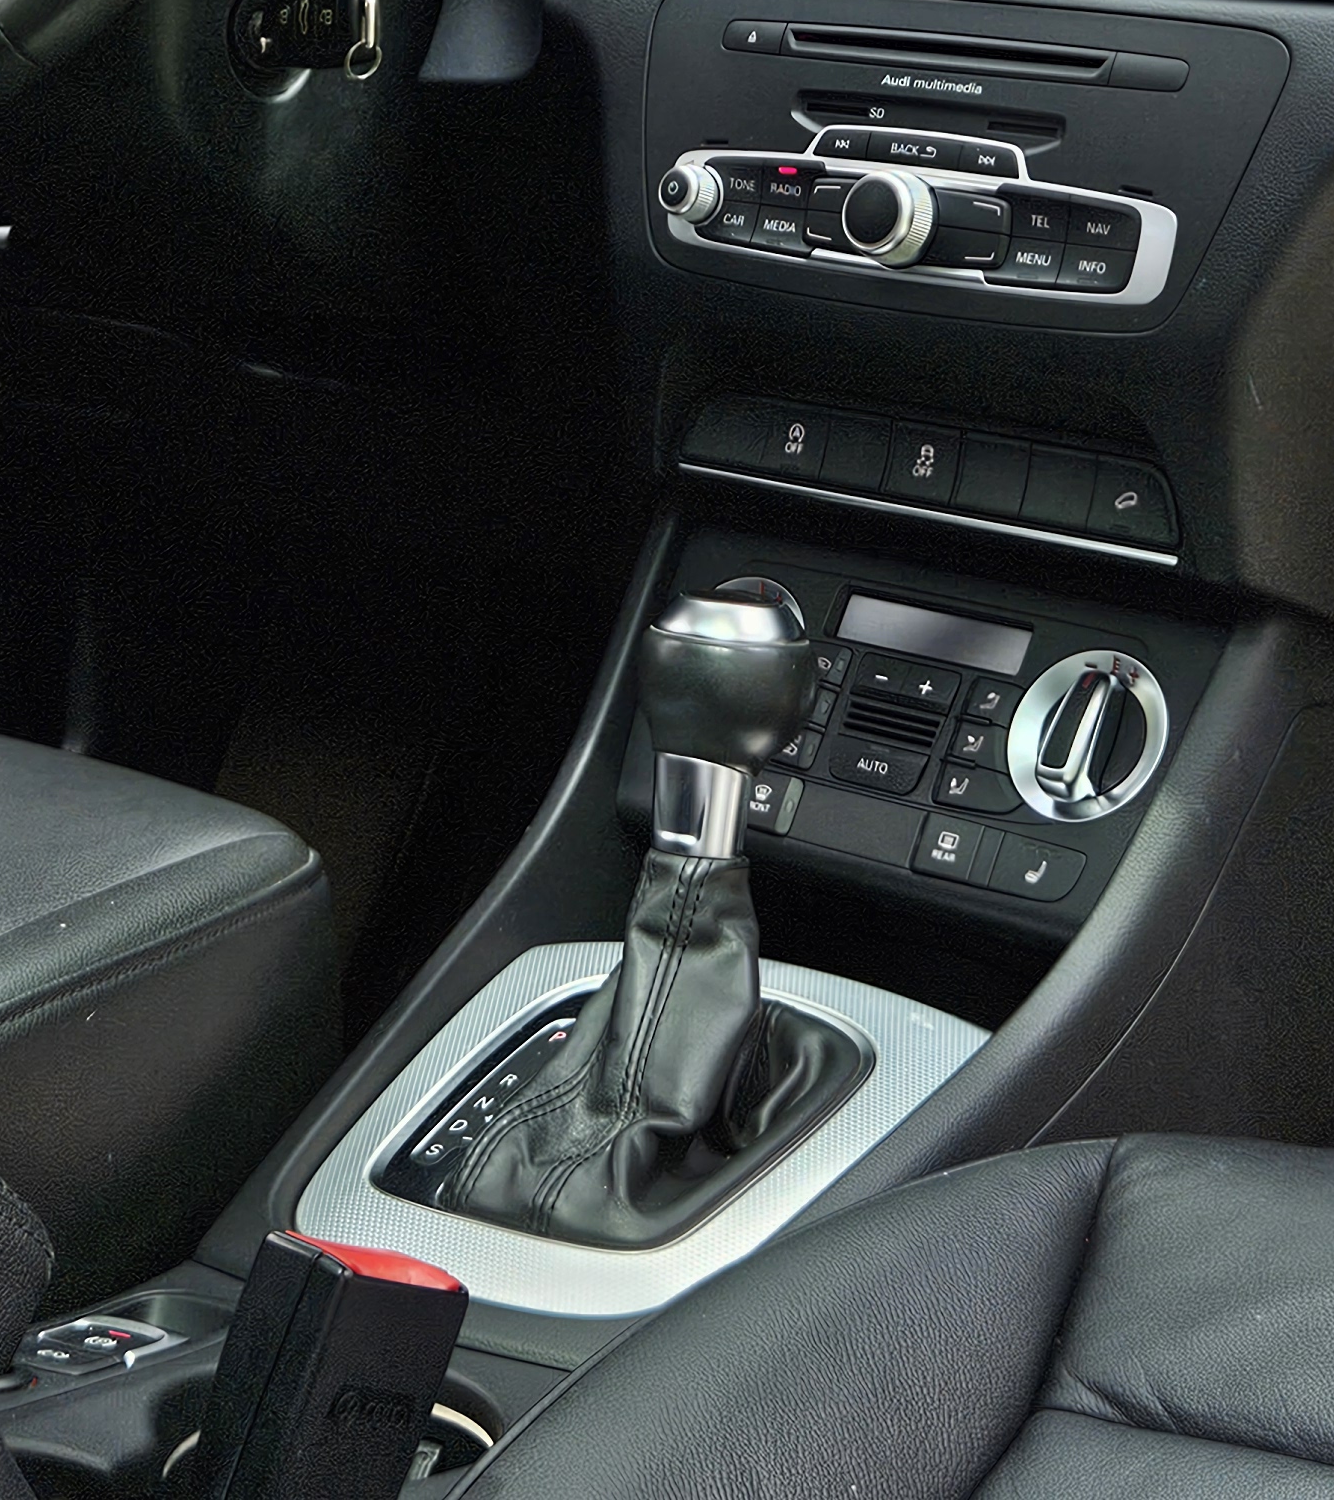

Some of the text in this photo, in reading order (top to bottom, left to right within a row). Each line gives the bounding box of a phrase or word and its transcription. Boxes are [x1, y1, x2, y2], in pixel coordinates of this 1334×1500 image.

[881, 74, 983, 95] Audi multimedia
[869, 107, 885, 119] SD
[890, 142, 919, 156] BACK
[730, 177, 756, 192] TONE
[770, 182, 802, 197] RADIO
[723, 213, 745, 227] CAR
[763, 218, 796, 233] MEDIA
[1031, 214, 1051, 229] TEL
[1086, 221, 1112, 235] NAV
[1015, 251, 1052, 266] MENU
[1078, 260, 1107, 274] INFO
[784, 441, 804, 455] OFF
[912, 465, 934, 478] OFF
[856, 757, 889, 775] AUTO
[930, 848, 956, 863] REAR
[548, 1031, 567, 1042] P
[499, 1073, 518, 1087] R
[473, 1096, 495, 1109] N
[448, 1119, 468, 1132] D
[425, 1143, 444, 1156] S
